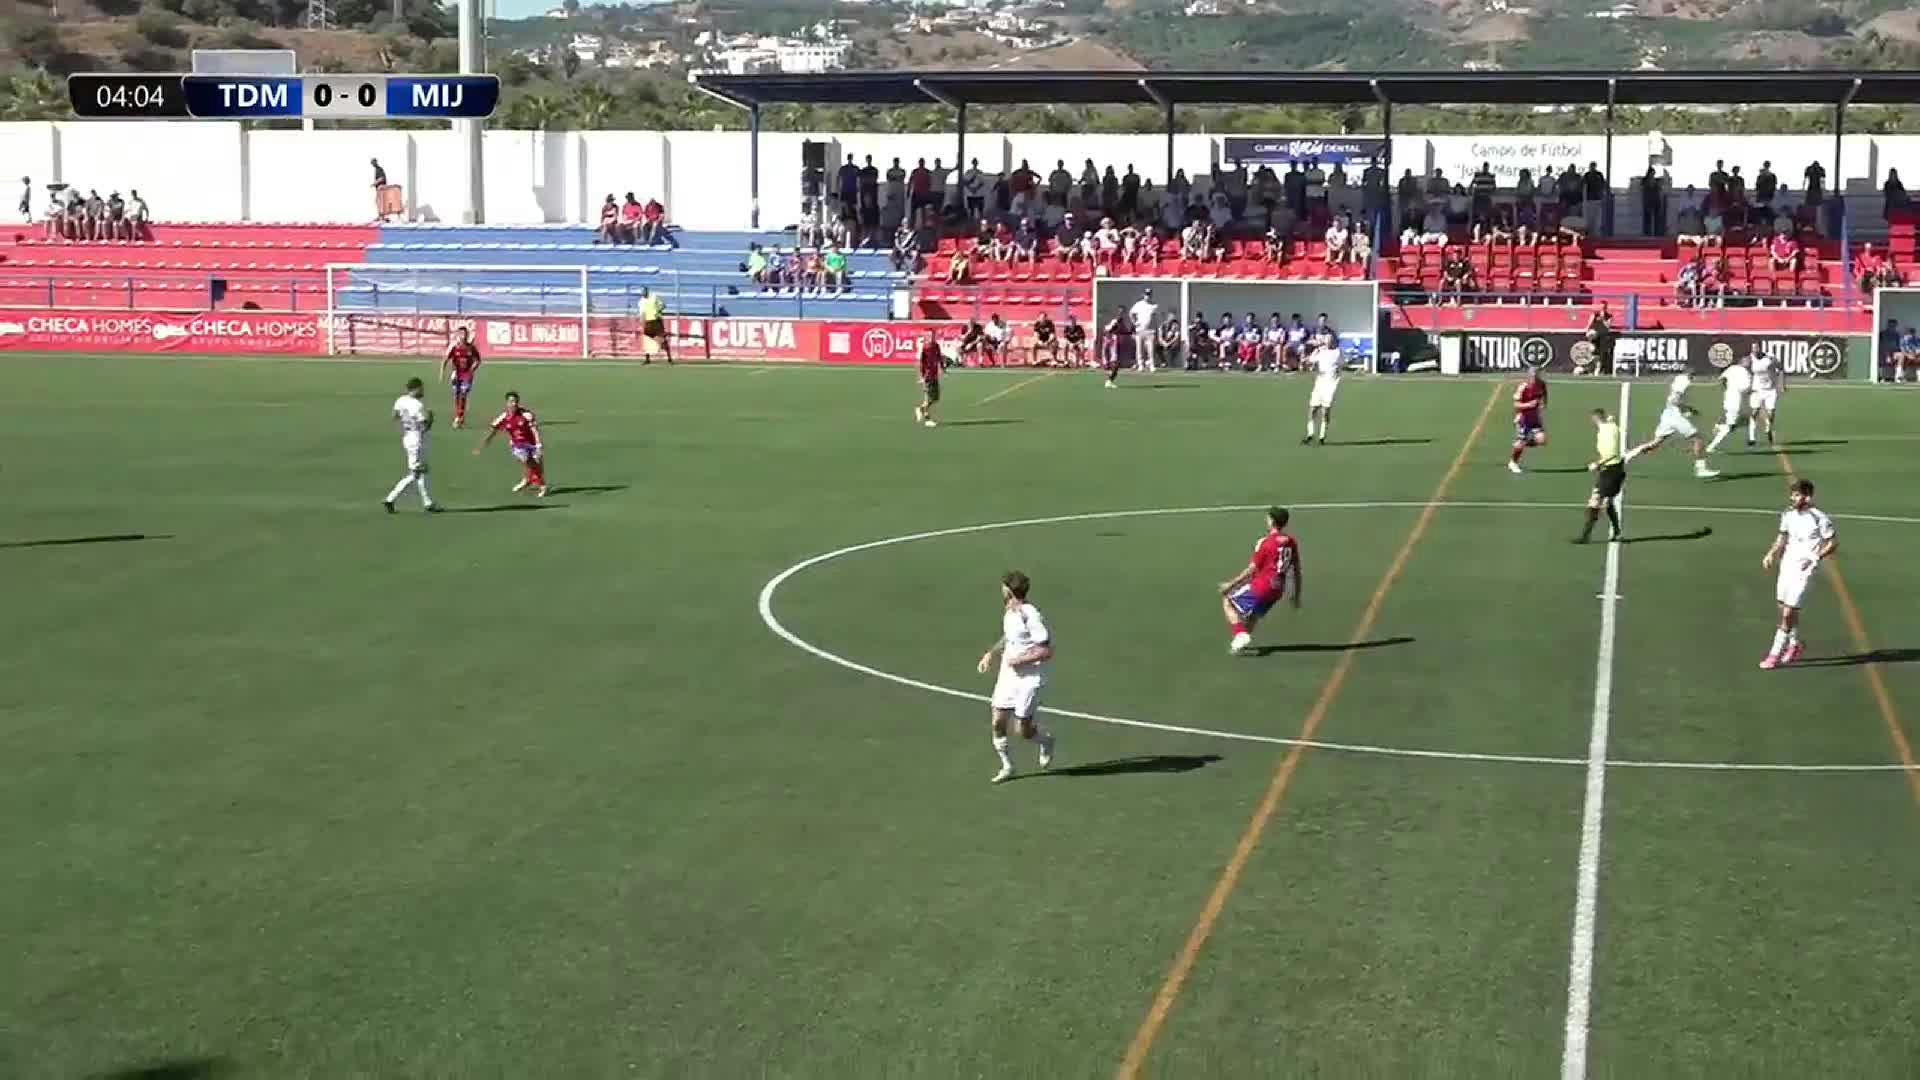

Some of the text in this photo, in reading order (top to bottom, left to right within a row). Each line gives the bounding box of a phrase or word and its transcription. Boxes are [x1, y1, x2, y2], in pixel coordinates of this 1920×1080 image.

[1324, 144, 1361, 153] DENTAL
[1471, 143, 1517, 158] Campo
[1520, 144, 1537, 157] de
[28, 317, 152, 334] CHECA HOMES
[191, 320, 317, 338] CHECA HOMES
[670, 319, 796, 349] LA CUEVA
